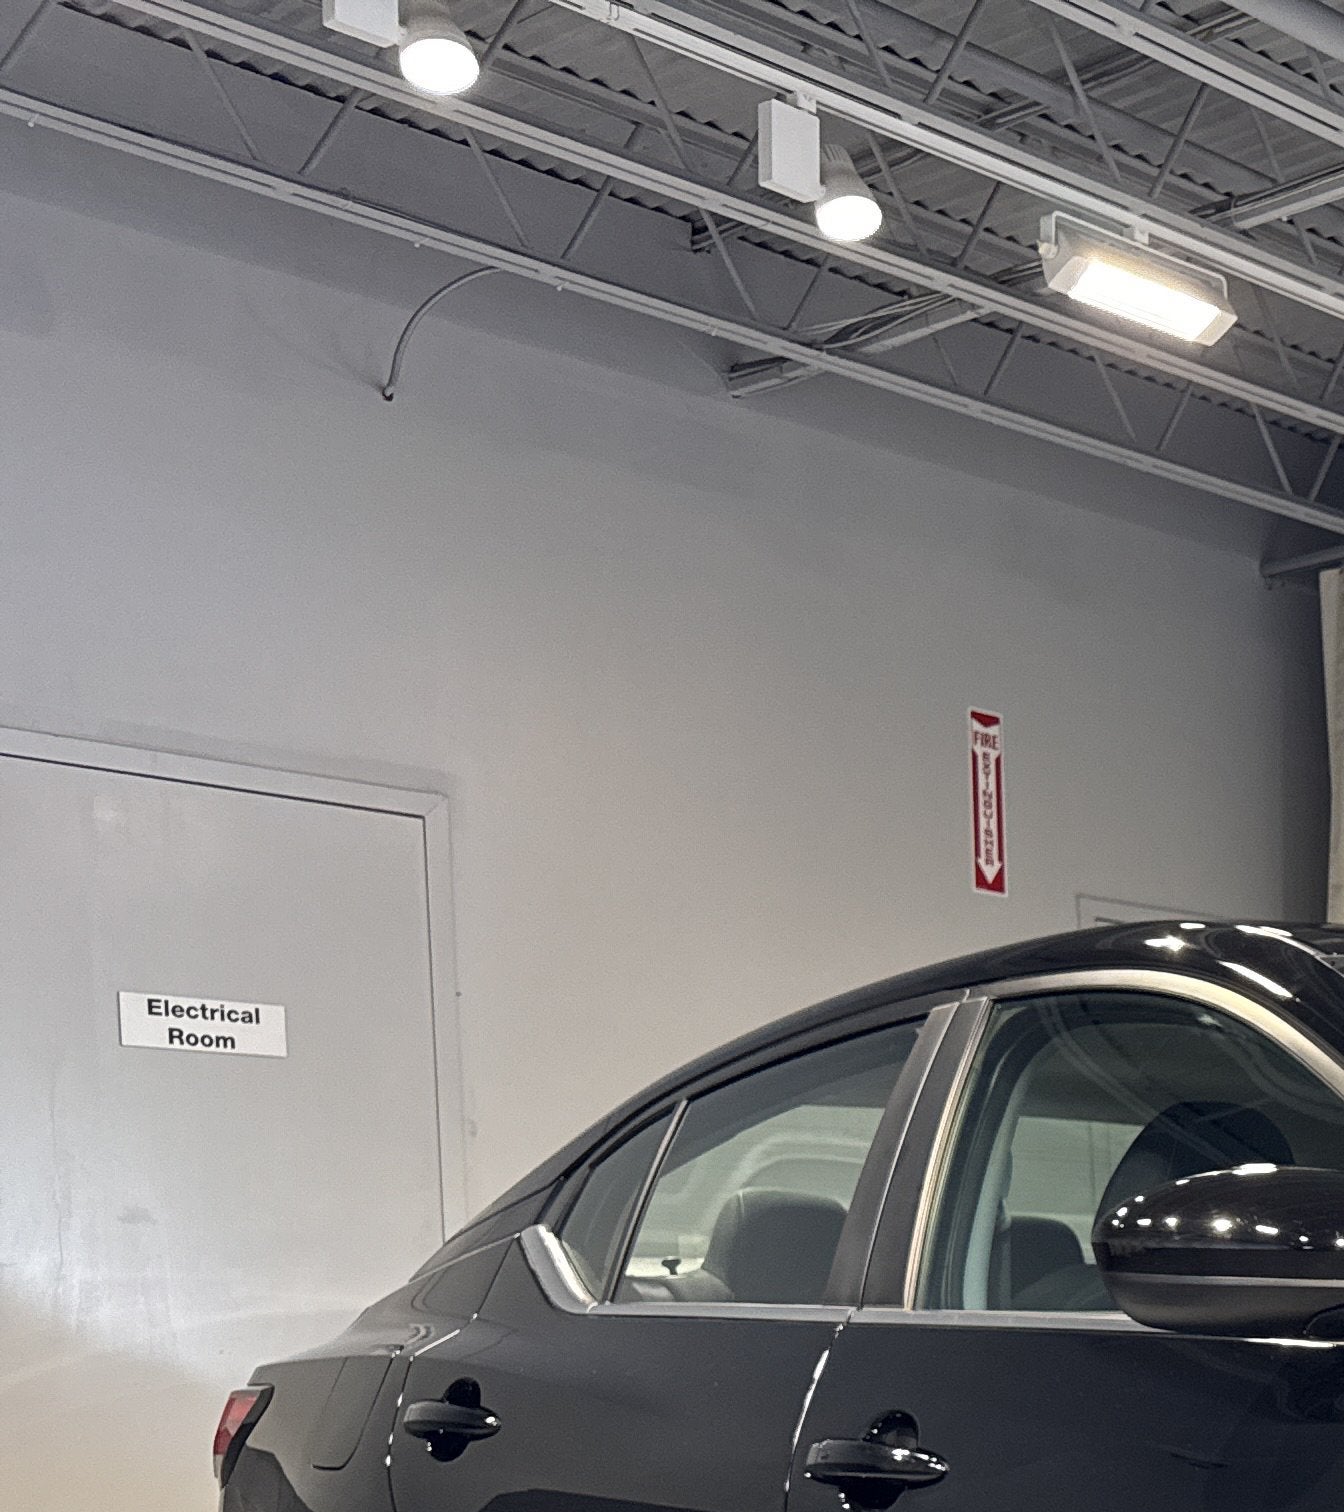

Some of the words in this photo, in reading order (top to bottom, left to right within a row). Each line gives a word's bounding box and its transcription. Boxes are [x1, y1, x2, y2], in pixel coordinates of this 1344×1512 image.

[974, 731, 999, 750] FIRE
[147, 999, 260, 1024] Electrical
[168, 1027, 236, 1049] Room
